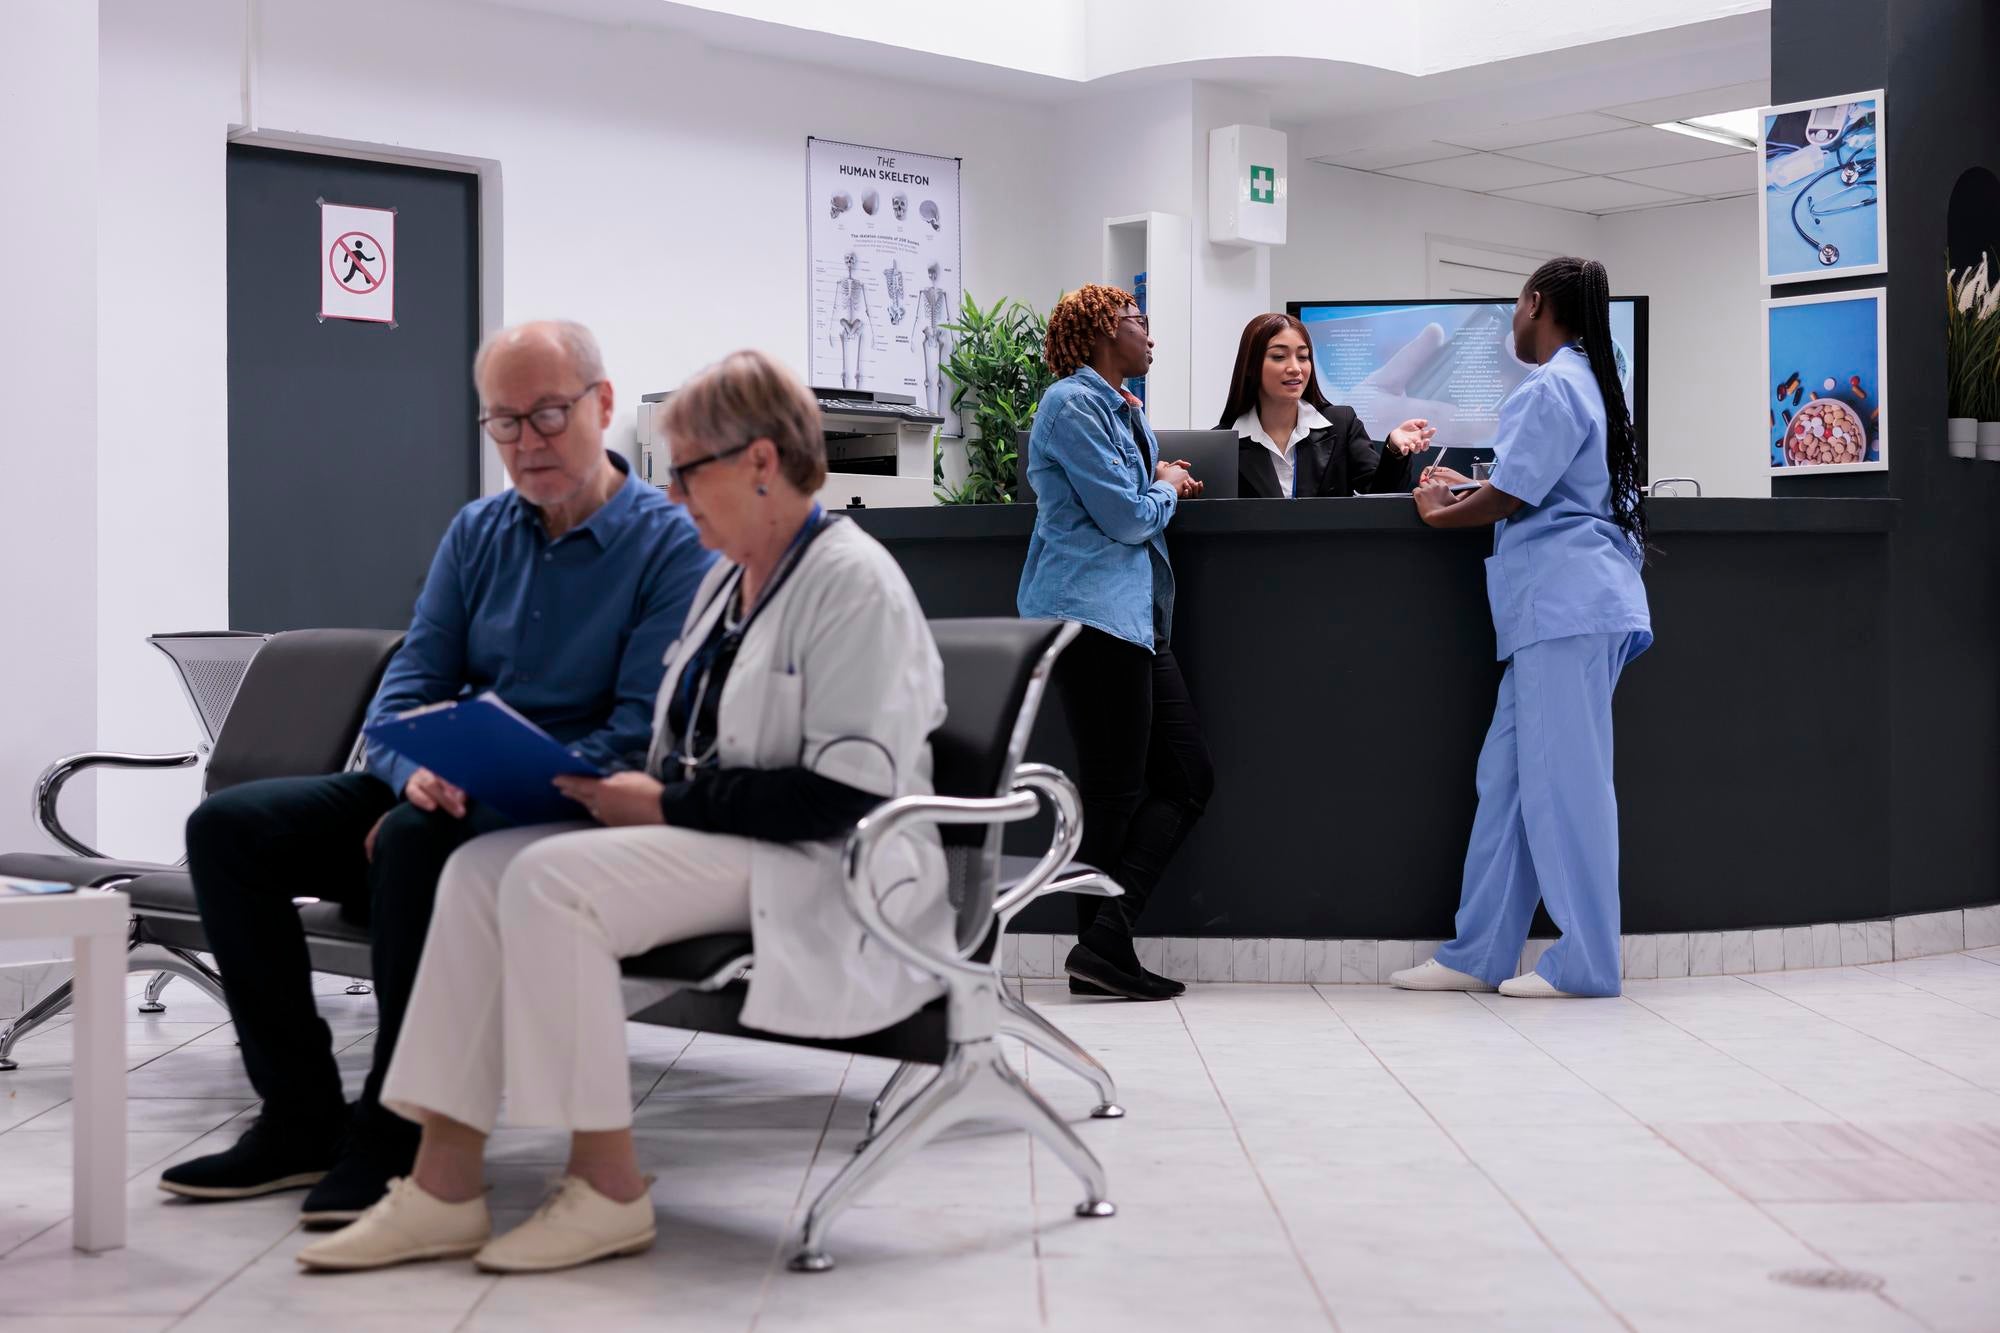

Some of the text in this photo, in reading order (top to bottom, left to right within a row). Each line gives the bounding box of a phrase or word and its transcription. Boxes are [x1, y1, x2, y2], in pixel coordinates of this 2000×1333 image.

[877, 156, 896, 168] THE
[840, 165, 929, 185] HUMAN SKELETON
